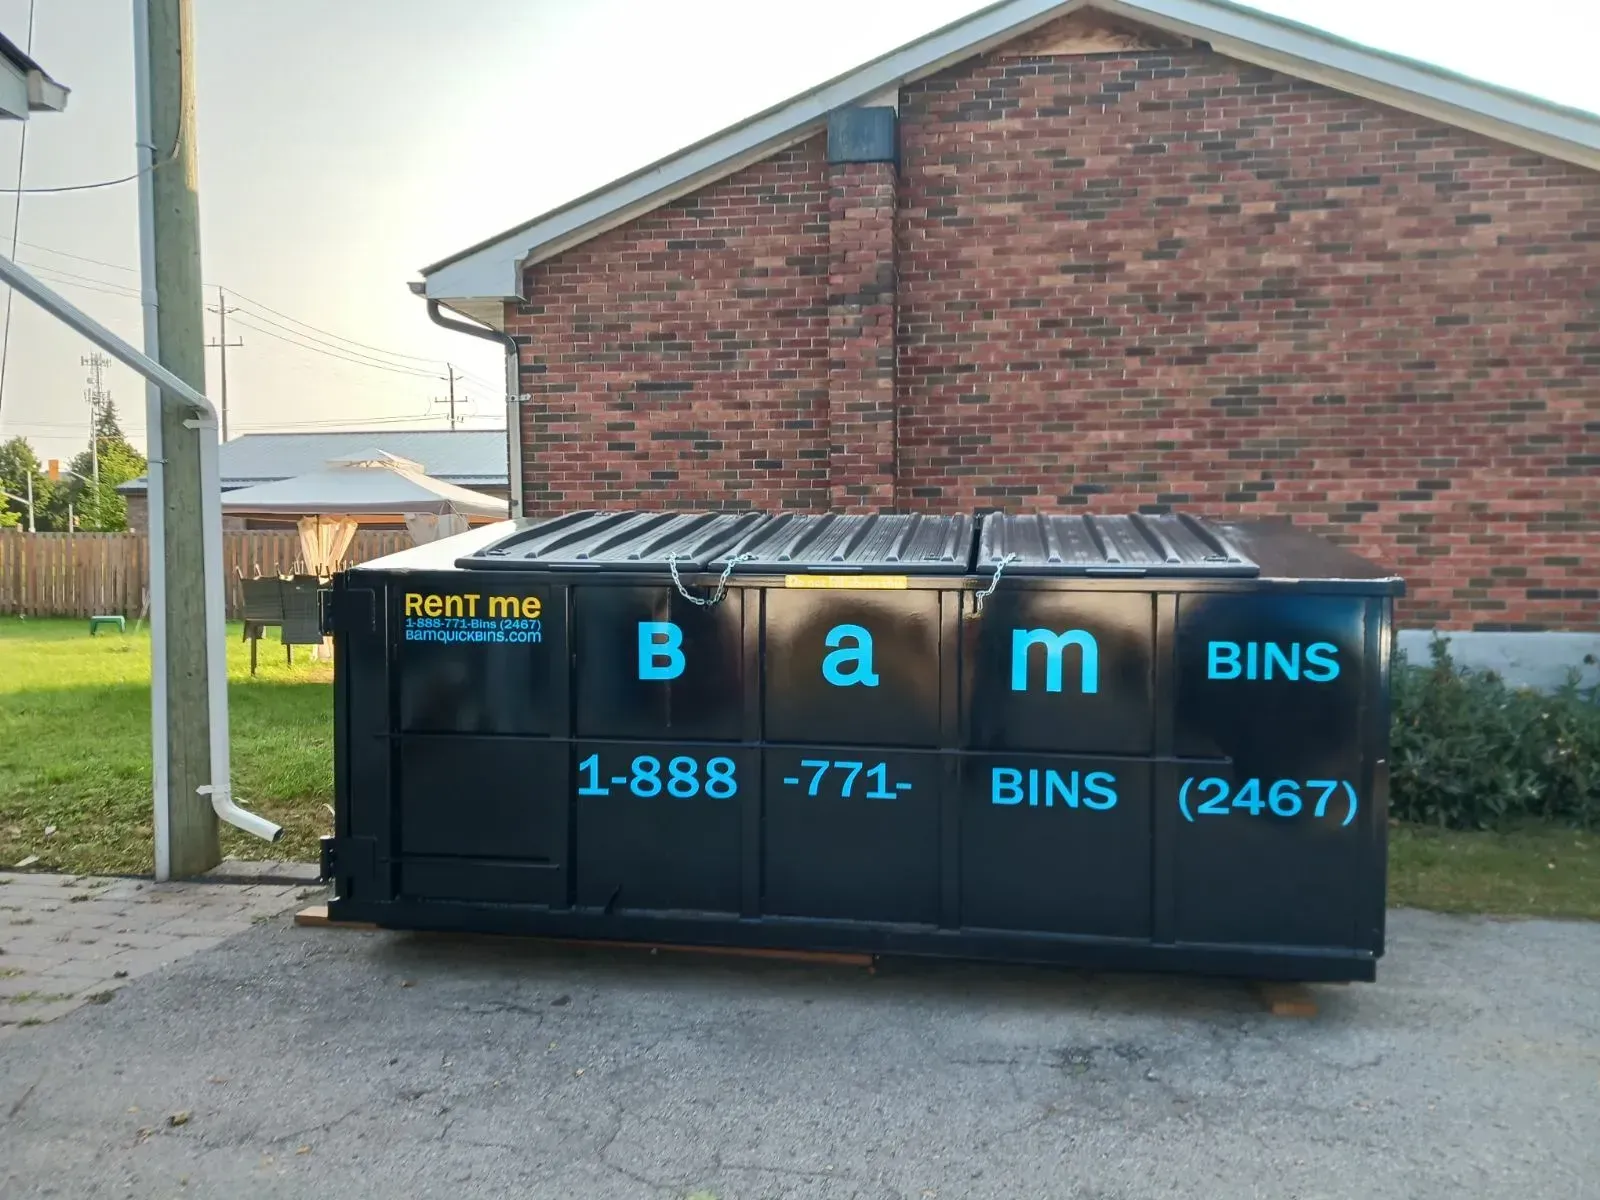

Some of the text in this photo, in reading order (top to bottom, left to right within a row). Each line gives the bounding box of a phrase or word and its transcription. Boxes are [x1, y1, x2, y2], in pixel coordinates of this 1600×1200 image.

[405, 618, 541, 631] 1-888-771-Bins (2467)
[488, 596, 542, 619] me
[638, 621, 1341, 694] B a m BINS
[578, 753, 1358, 827] 1-888 -771- BINS (2467)
